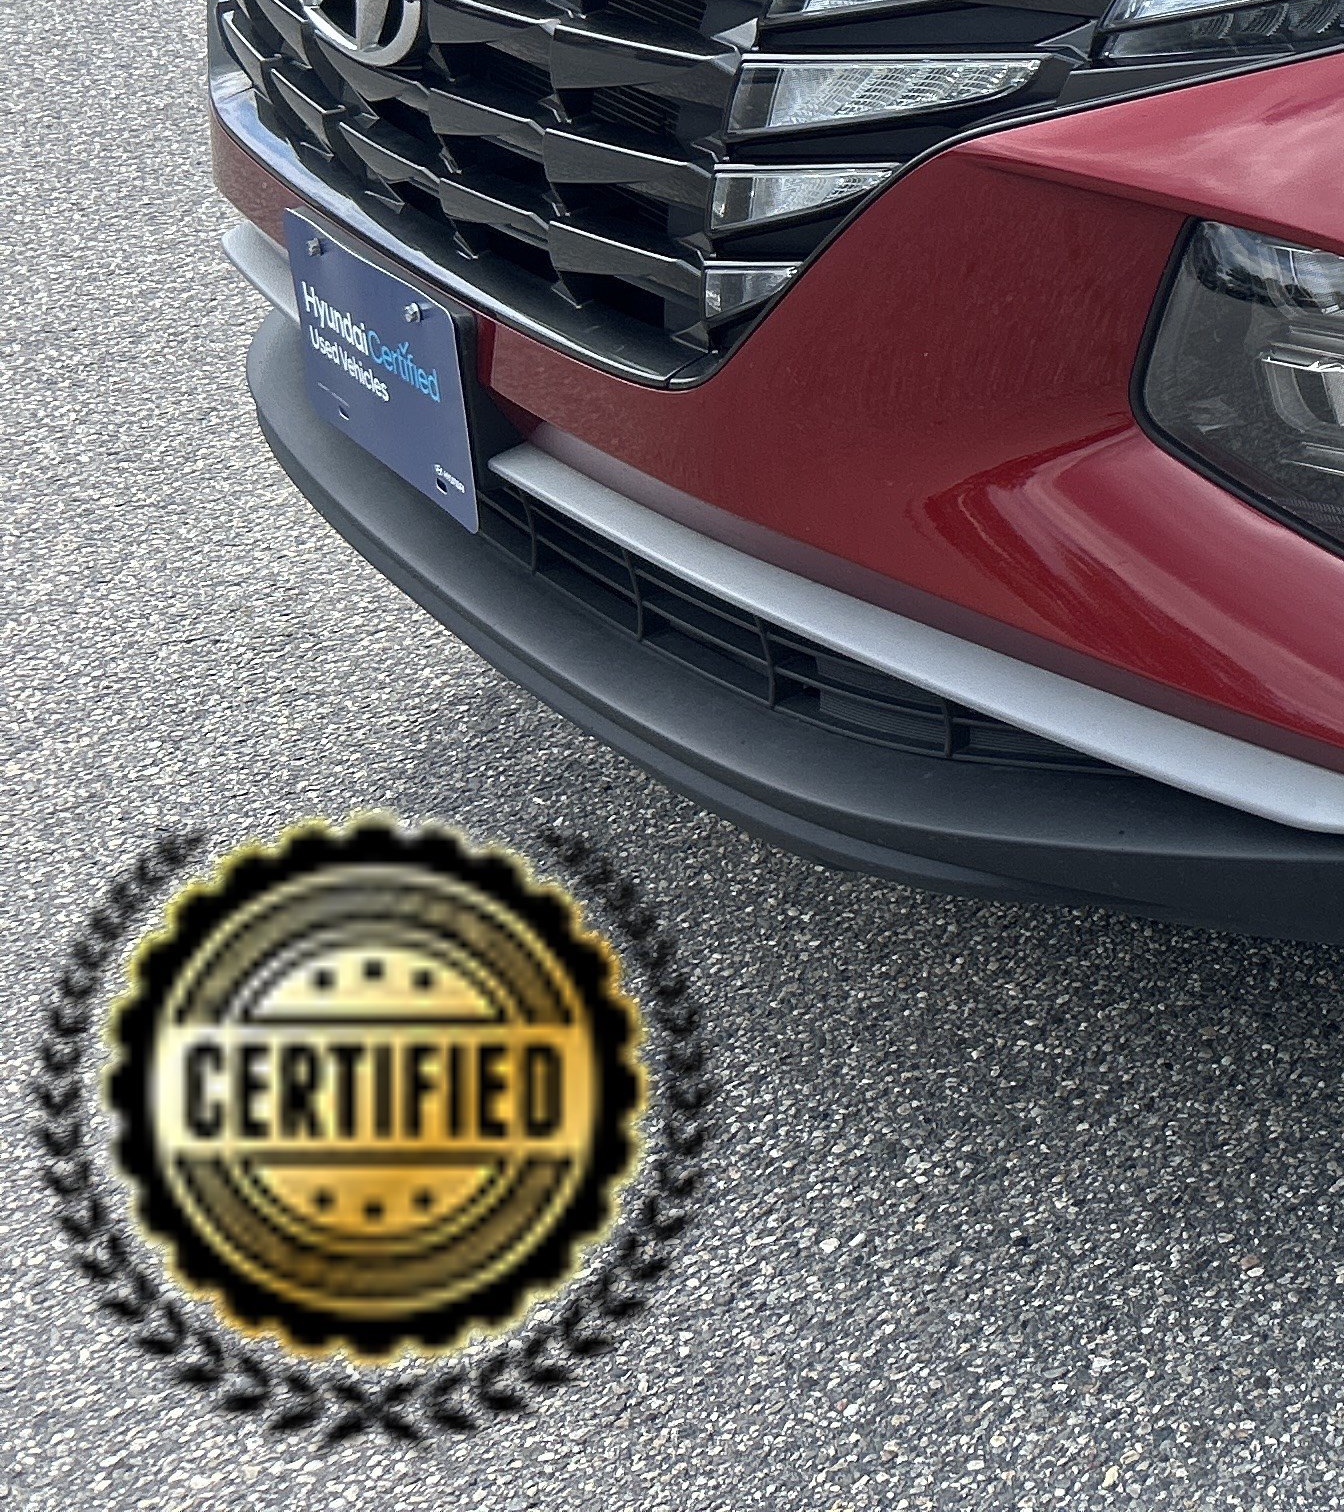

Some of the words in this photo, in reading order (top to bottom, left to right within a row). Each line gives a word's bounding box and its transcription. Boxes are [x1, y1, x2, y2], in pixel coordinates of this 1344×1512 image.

[301, 280, 369, 356] Hyundai
[367, 330, 441, 403] Certified
[309, 324, 341, 365] Used
[338, 345, 390, 402] Vehicles
